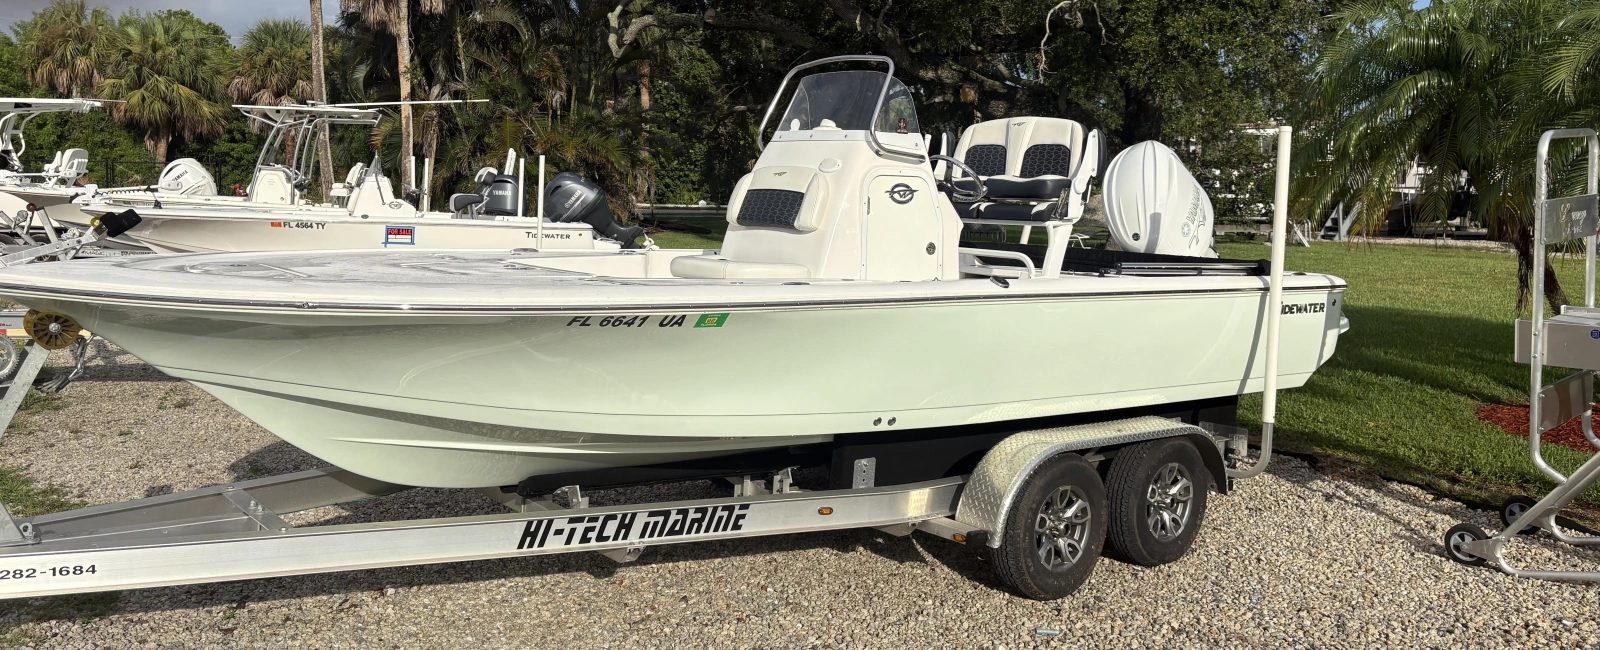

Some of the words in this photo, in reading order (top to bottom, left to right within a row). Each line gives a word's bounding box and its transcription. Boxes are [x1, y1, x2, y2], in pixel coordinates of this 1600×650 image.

[568, 189, 582, 205] YAMAHA
[283, 221, 293, 229] FL
[315, 222, 326, 230] TY
[1280, 300, 1325, 315] IDEWATER
[566, 315, 592, 327] FL
[599, 315, 650, 328] 6641
[658, 314, 687, 328] UA
[516, 511, 639, 550] HI-TECH
[638, 503, 751, 539] MARINE
[0, 564, 97, 580] 282-1684
